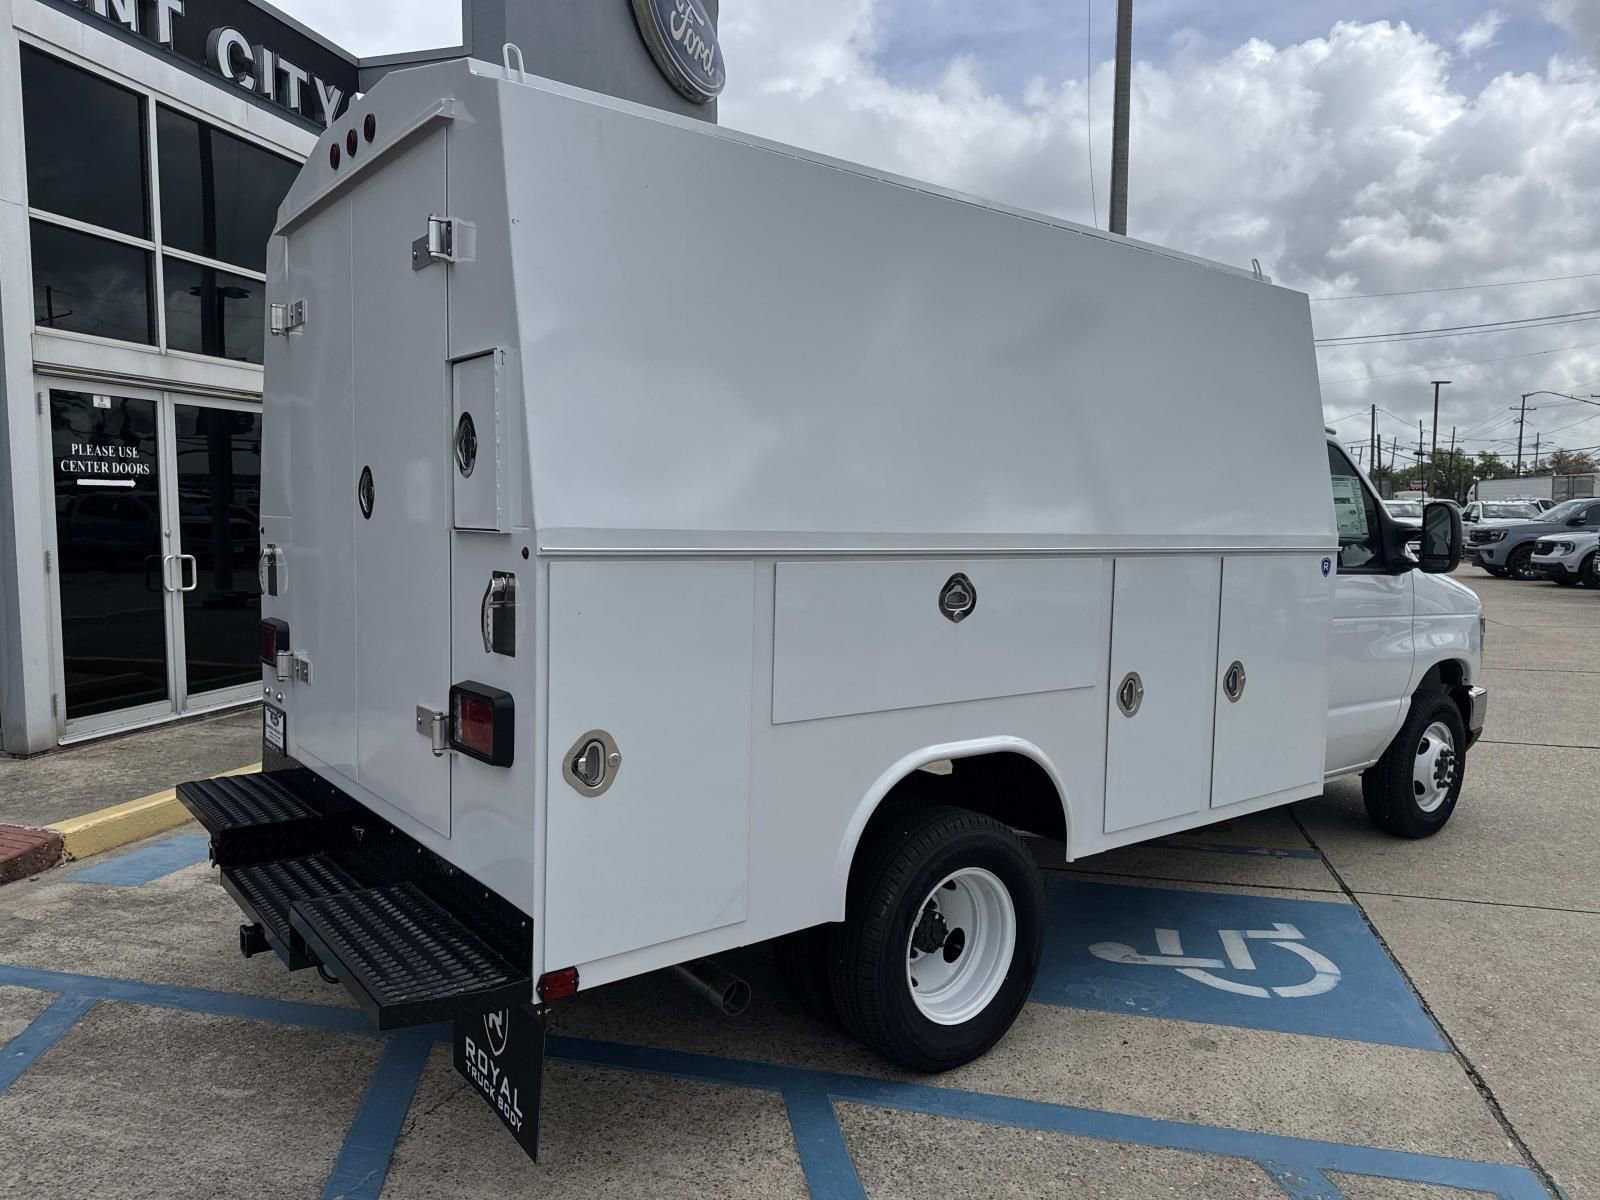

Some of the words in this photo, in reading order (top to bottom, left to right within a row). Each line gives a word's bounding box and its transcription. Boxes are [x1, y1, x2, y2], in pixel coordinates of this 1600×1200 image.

[670, 0, 715, 77] Ford
[207, 26, 344, 128] CITY
[60, 459, 110, 473] CENTER
[112, 462, 150, 475] DOORS
[71, 443, 116, 457] PLEASE
[118, 446, 140, 458] USE
[465, 1036, 523, 1118] ROYAL
[465, 1059, 496, 1101] TRUCK
[498, 1097, 523, 1133] BODY
